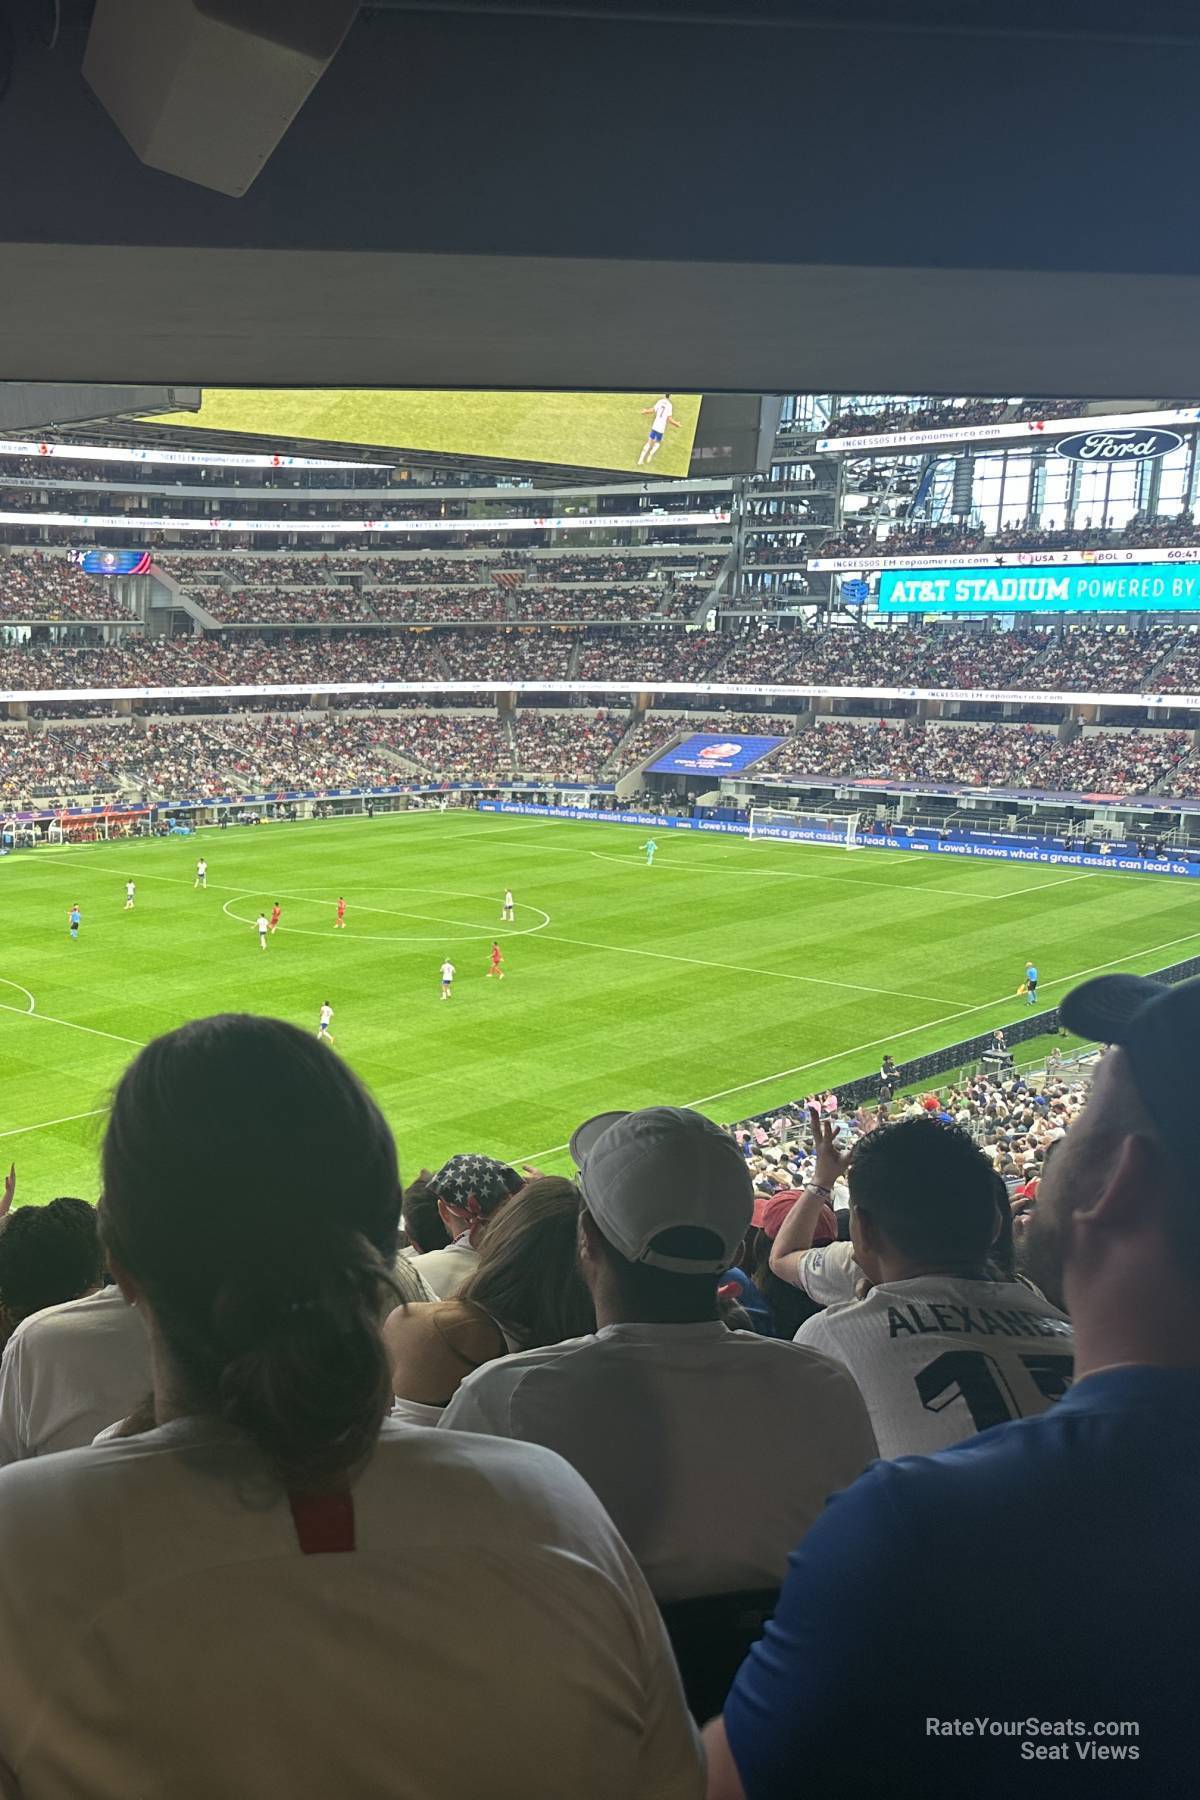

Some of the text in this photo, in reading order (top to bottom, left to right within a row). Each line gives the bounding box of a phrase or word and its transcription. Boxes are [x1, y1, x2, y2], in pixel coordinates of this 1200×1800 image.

[842, 437, 890, 446] INGRESSOS
[1079, 432, 1157, 459] Ford
[1035, 554, 1054, 562] USA
[1167, 550, 1198, 558] 60:41
[890, 577, 1194, 602] AT&T STADIUM POWERED BY
[501, 804, 524, 813] Lowe's
[525, 806, 548, 814] knows
[550, 808, 569, 816] what
[576, 810, 597, 819] great
[599, 812, 621, 820] assist
[638, 815, 656, 824] lead
[658, 817, 668, 825] to.
[699, 822, 725, 832] Lowe's
[758, 826, 779, 835] what
[789, 830, 814, 840] great
[816, 831, 842, 841] assist
[864, 835, 885, 846] lead
[887, 837, 900, 847] to.
[938, 843, 972, 854] Lowe's
[974, 846, 1008, 856] knows
[1010, 849, 1038, 860] what
[1050, 853, 1081, 866] great
[1084, 855, 1116, 867] assist
[1119, 860, 1140, 869] can
[1144, 860, 1170, 871] lead
[1173, 863, 1188, 874] to.
